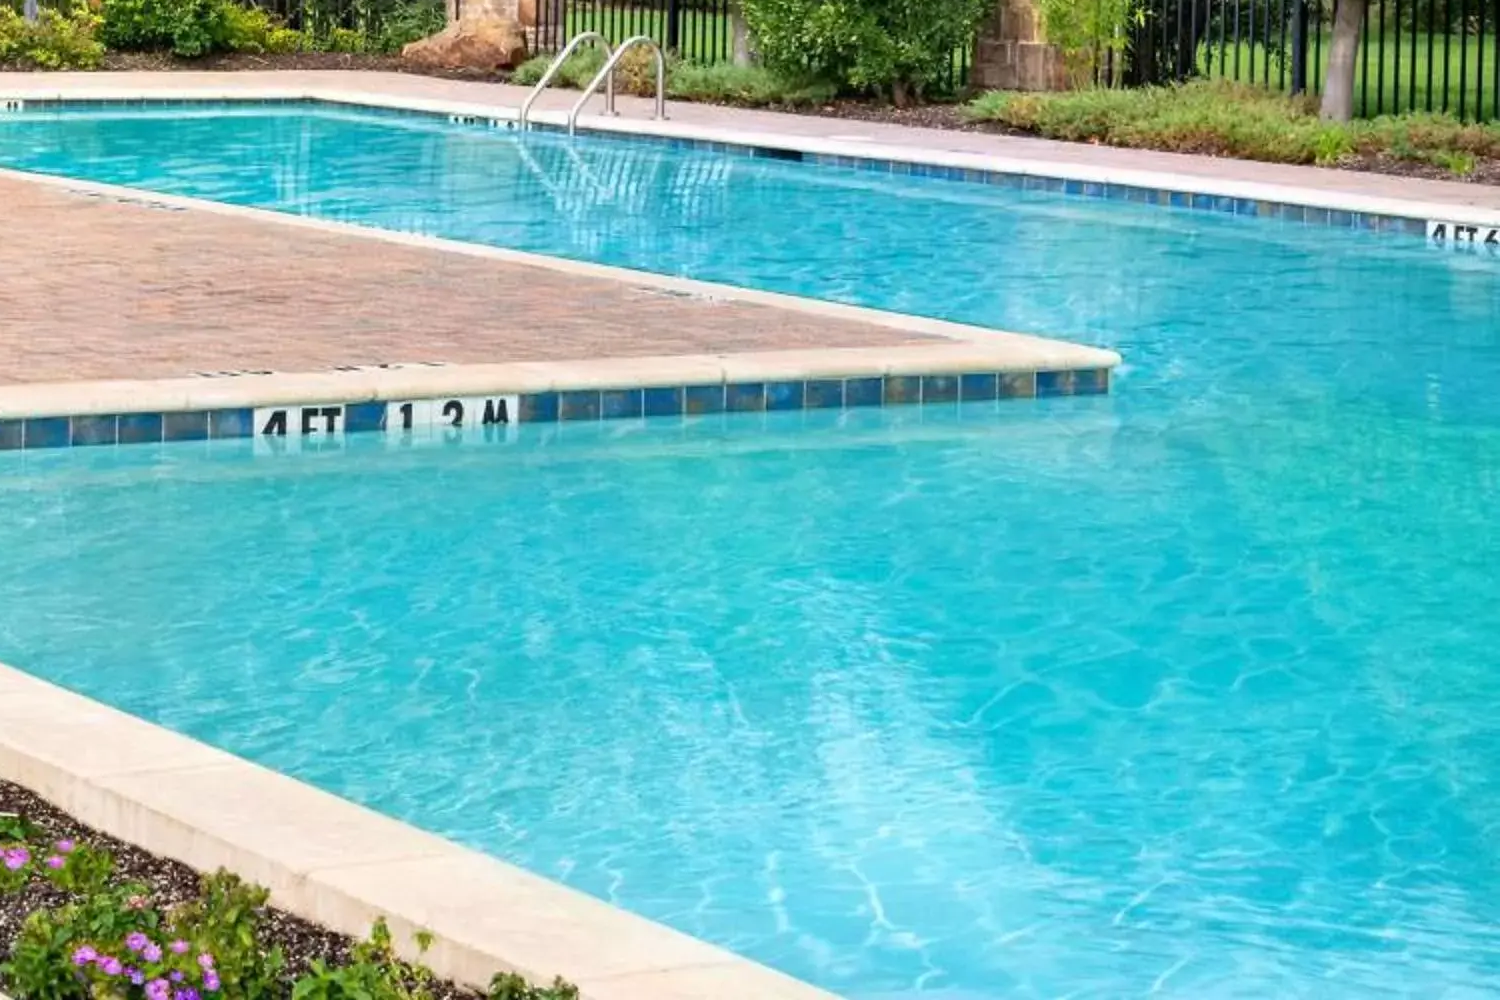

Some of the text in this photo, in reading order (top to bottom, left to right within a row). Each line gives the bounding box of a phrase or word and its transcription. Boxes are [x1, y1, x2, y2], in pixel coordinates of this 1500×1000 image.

[1432, 223, 1447, 240] 4
[1454, 225, 1478, 242] FT
[261, 407, 342, 436] 4 FT
[399, 403, 413, 429] 1
[482, 398, 509, 425] M
